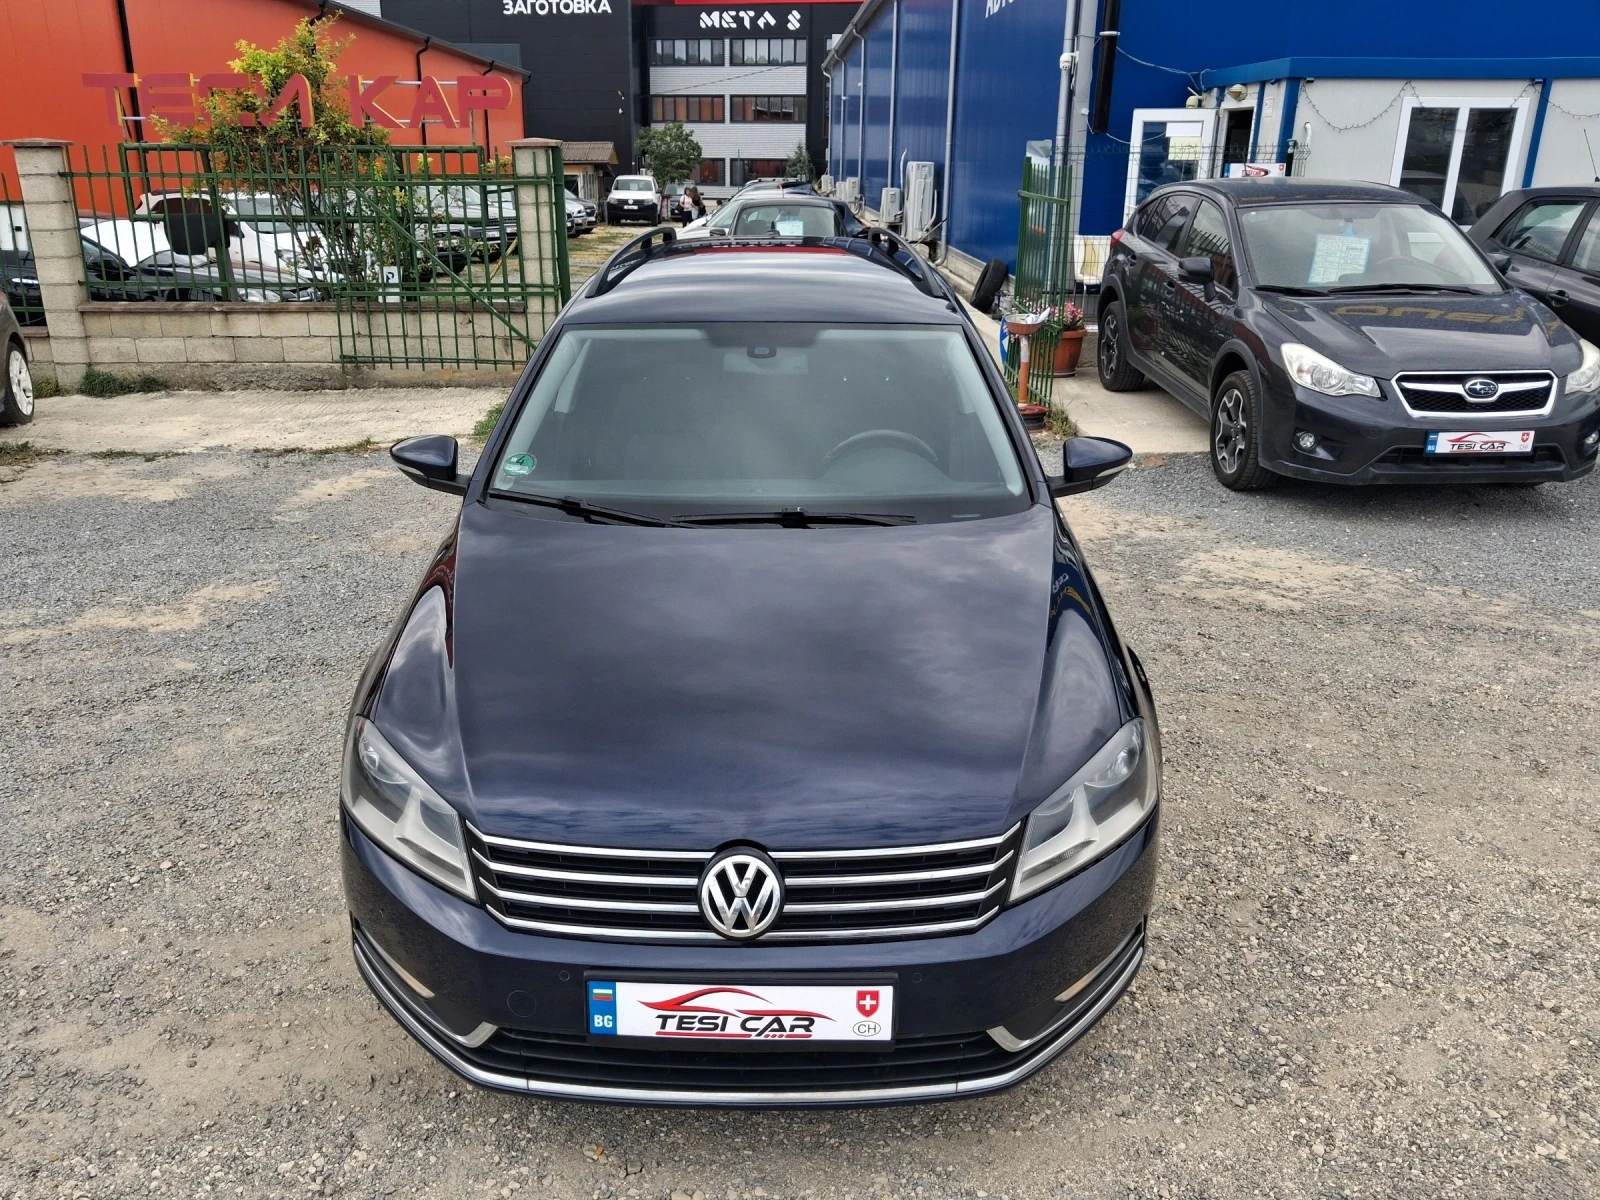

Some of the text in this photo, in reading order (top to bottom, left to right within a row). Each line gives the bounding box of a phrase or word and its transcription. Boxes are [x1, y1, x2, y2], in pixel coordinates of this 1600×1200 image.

[503, 0, 613, 15] ЗАГОТОВКА
[787, 9, 802, 31] 8
[346, 74, 513, 129] КАР
[1450, 443, 1506, 452] TESI CAR
[516, 455, 526, 466] 4
[593, 1013, 613, 1028] BG
[655, 1014, 816, 1037] TESI CAR
[857, 1023, 878, 1034] CH
